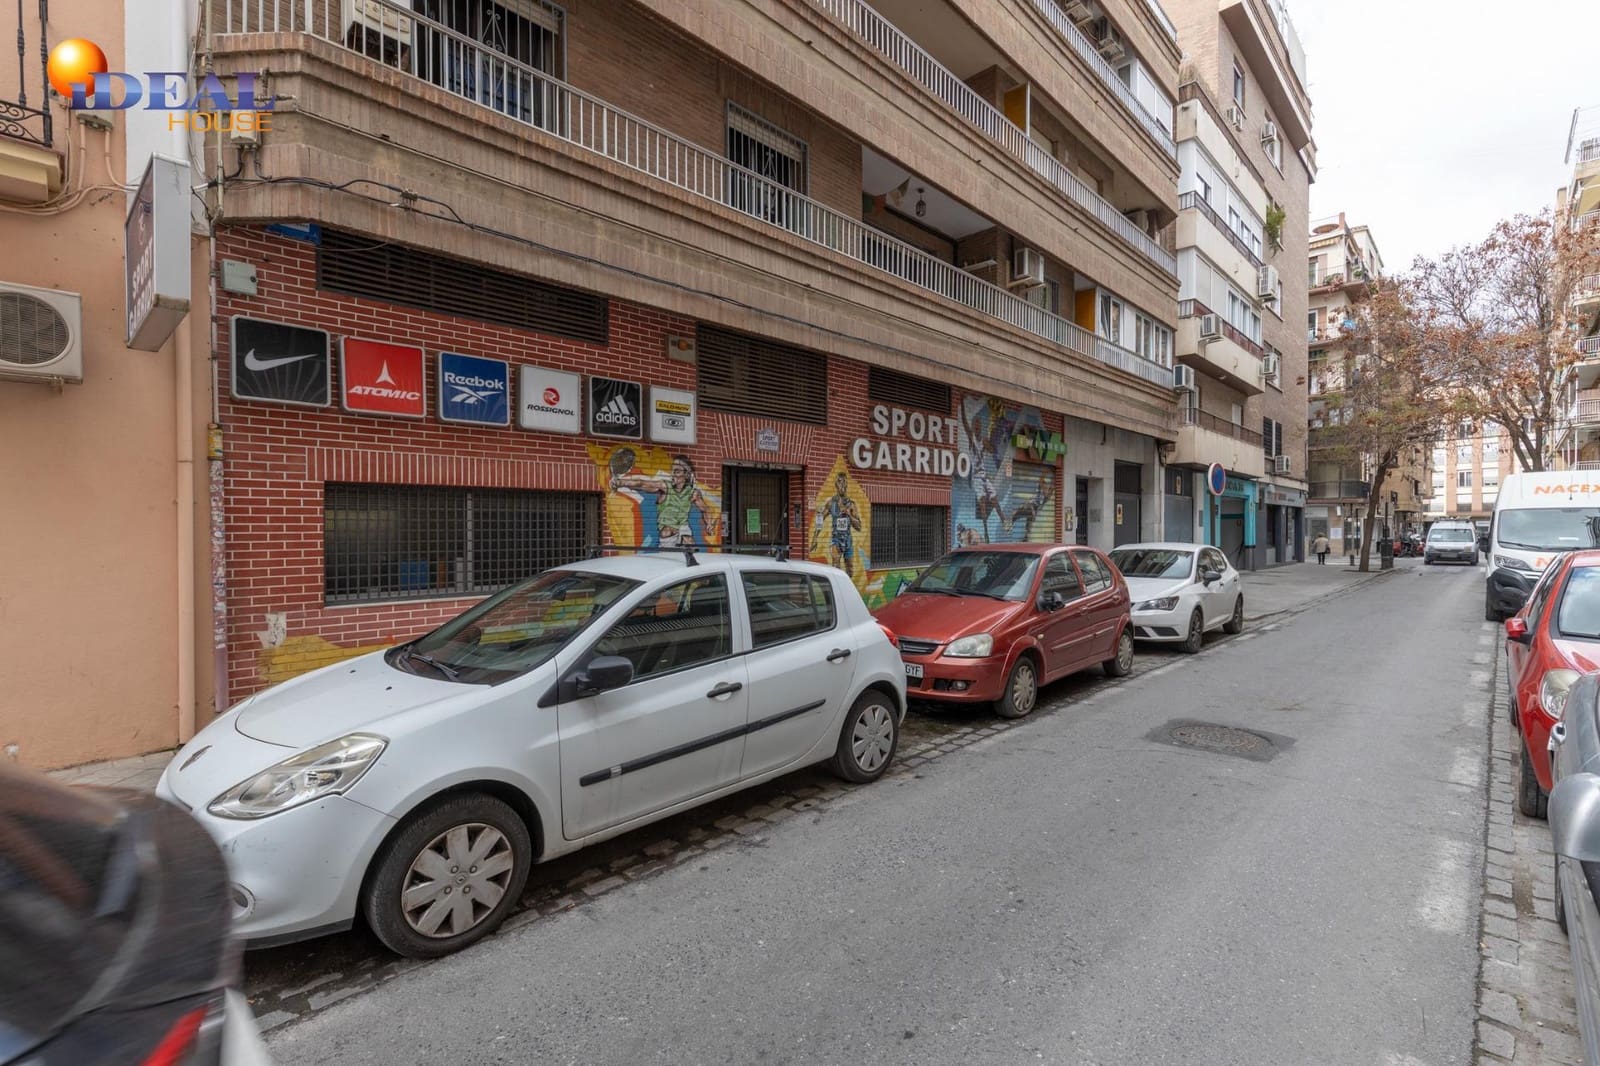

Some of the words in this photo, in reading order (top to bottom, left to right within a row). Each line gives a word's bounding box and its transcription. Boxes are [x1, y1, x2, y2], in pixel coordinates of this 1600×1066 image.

[133, 237, 153, 301] SPORT
[444, 372, 504, 390] Reebok
[348, 385, 421, 401] ATOMIC
[527, 404, 575, 416] ROSSIGNOL
[595, 411, 637, 426] adidas
[873, 405, 959, 444] SPORT
[853, 438, 971, 477] GARRIDO
